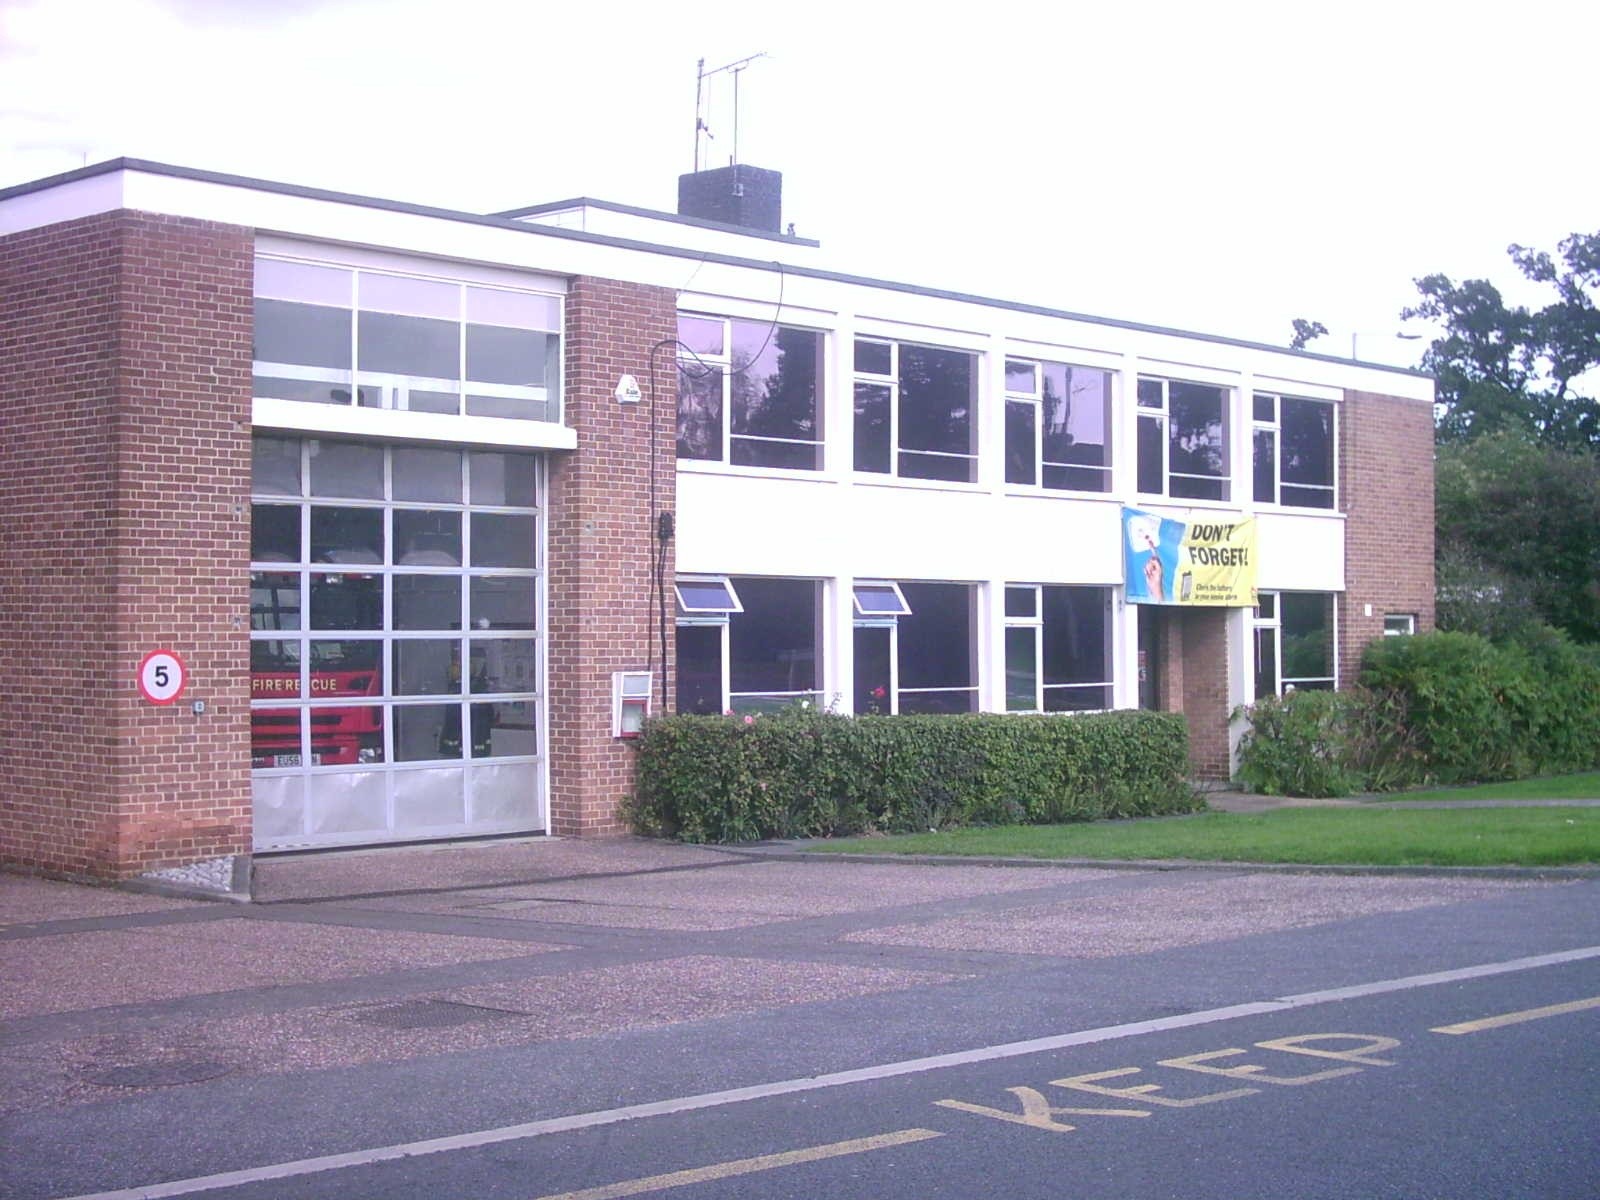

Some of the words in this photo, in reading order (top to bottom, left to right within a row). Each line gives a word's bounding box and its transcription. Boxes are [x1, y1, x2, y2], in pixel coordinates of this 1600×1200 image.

[1191, 524, 1235, 542] DON'T
[1188, 546, 1248, 566] FORGET!
[155, 665, 169, 687] 5
[252, 679, 282, 691] FIRE
[285, 679, 336, 691] RECUE
[932, 1033, 1401, 1132] KEEP
